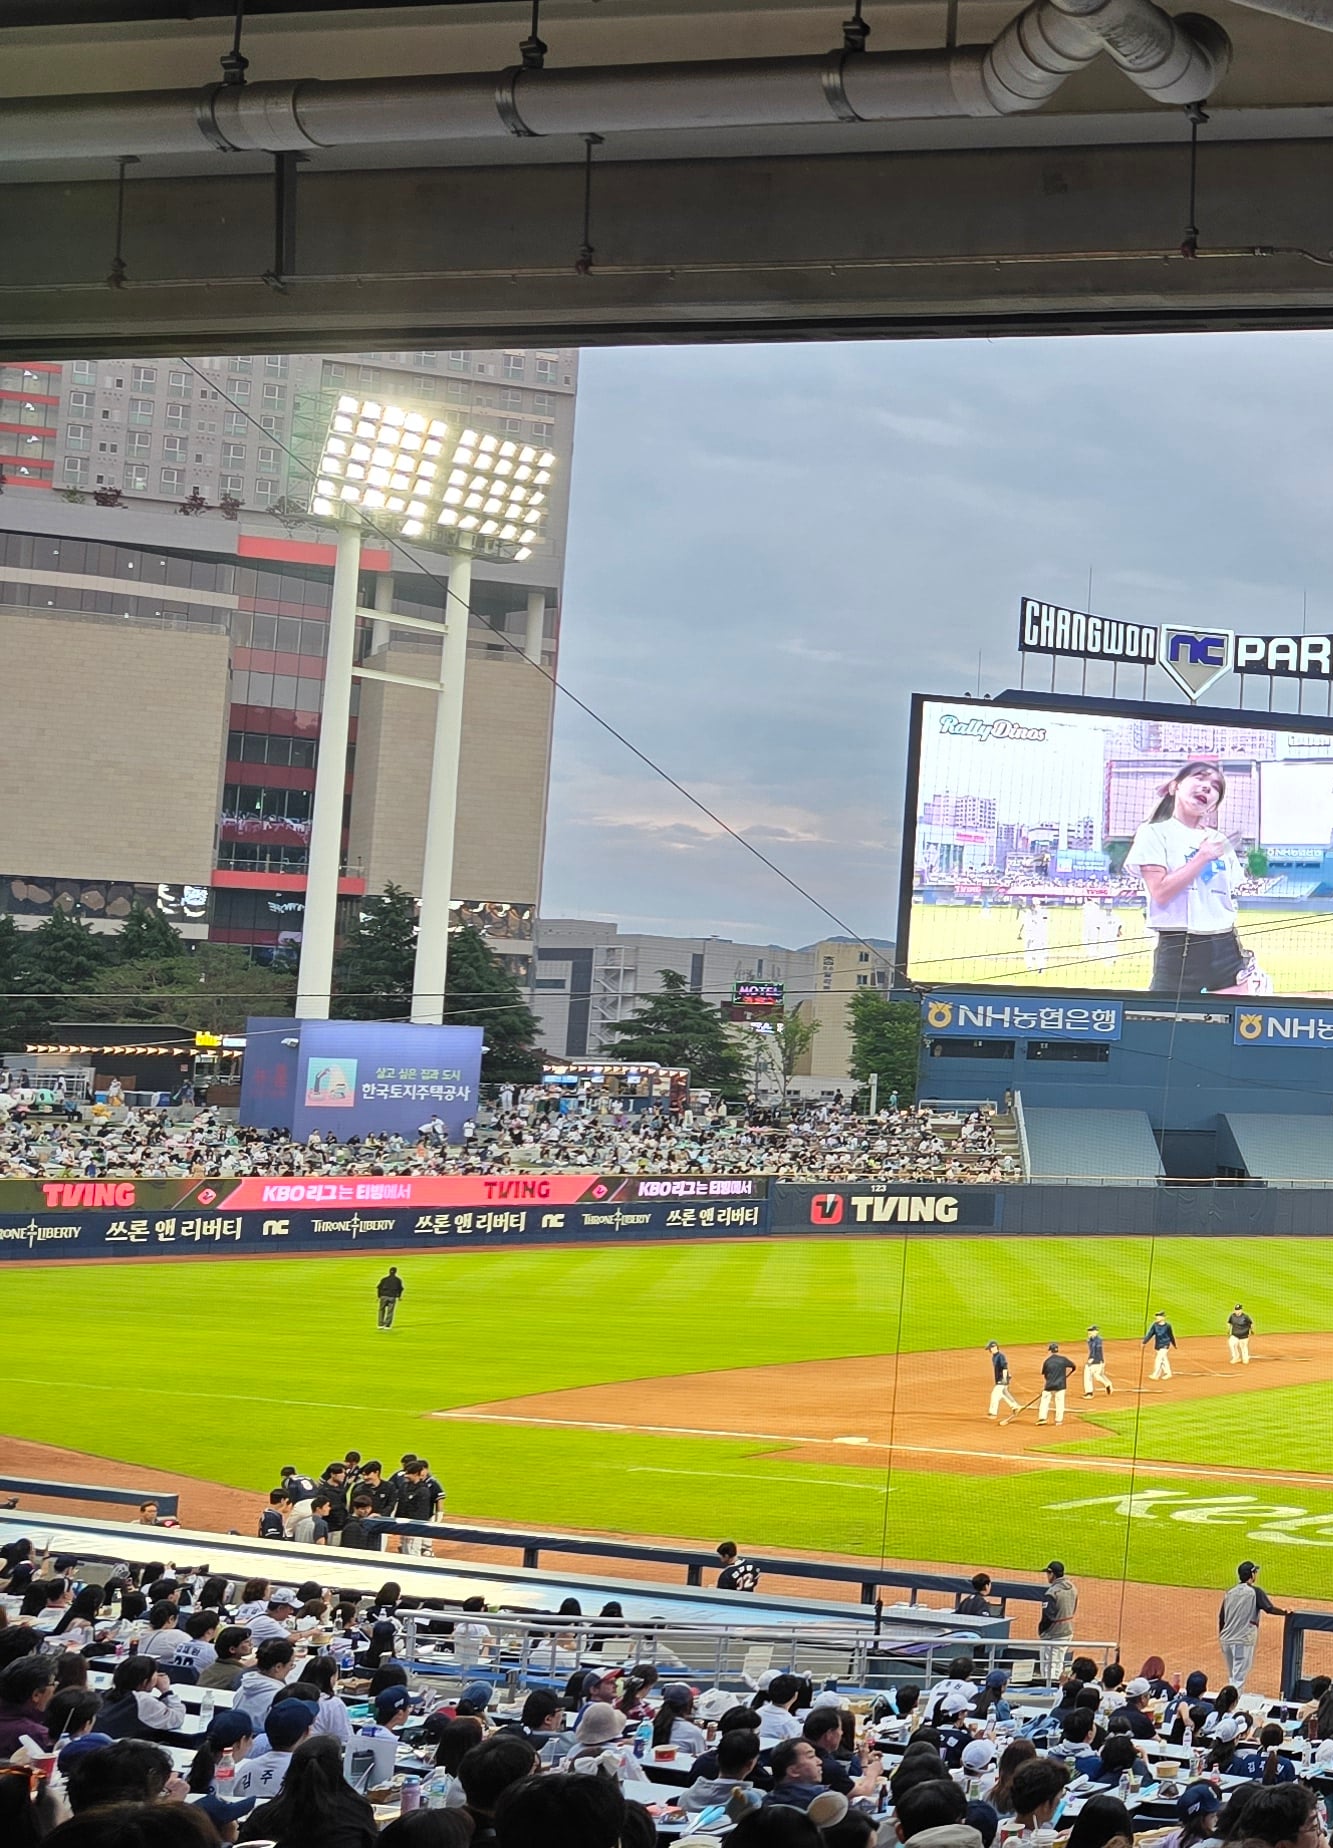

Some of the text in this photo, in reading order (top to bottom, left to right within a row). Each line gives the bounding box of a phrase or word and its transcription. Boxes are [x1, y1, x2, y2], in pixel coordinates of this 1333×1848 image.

[1024, 602, 1156, 658] CHANGWON
[739, 986, 781, 996] MOTEL
[958, 1004, 1116, 1034] NH농협은행
[362, 1083, 471, 1102] 한국토지주택공사
[42, 1182, 136, 1208] TVING
[484, 1181, 551, 1200] TVING
[871, 1185, 887, 1193] 123
[665, 1206, 759, 1227] 쓰론 앤 리버티
[851, 1196, 959, 1223] TVING
[37, 1225, 82, 1241] LIBERTY
[105, 1216, 243, 1242] 쓰론 앤 리버티
[359, 1219, 396, 1233] LIBERTY
[414, 1211, 527, 1235] 쓰론 앤 리버티
[242, 1770, 272, 1789] 김주
